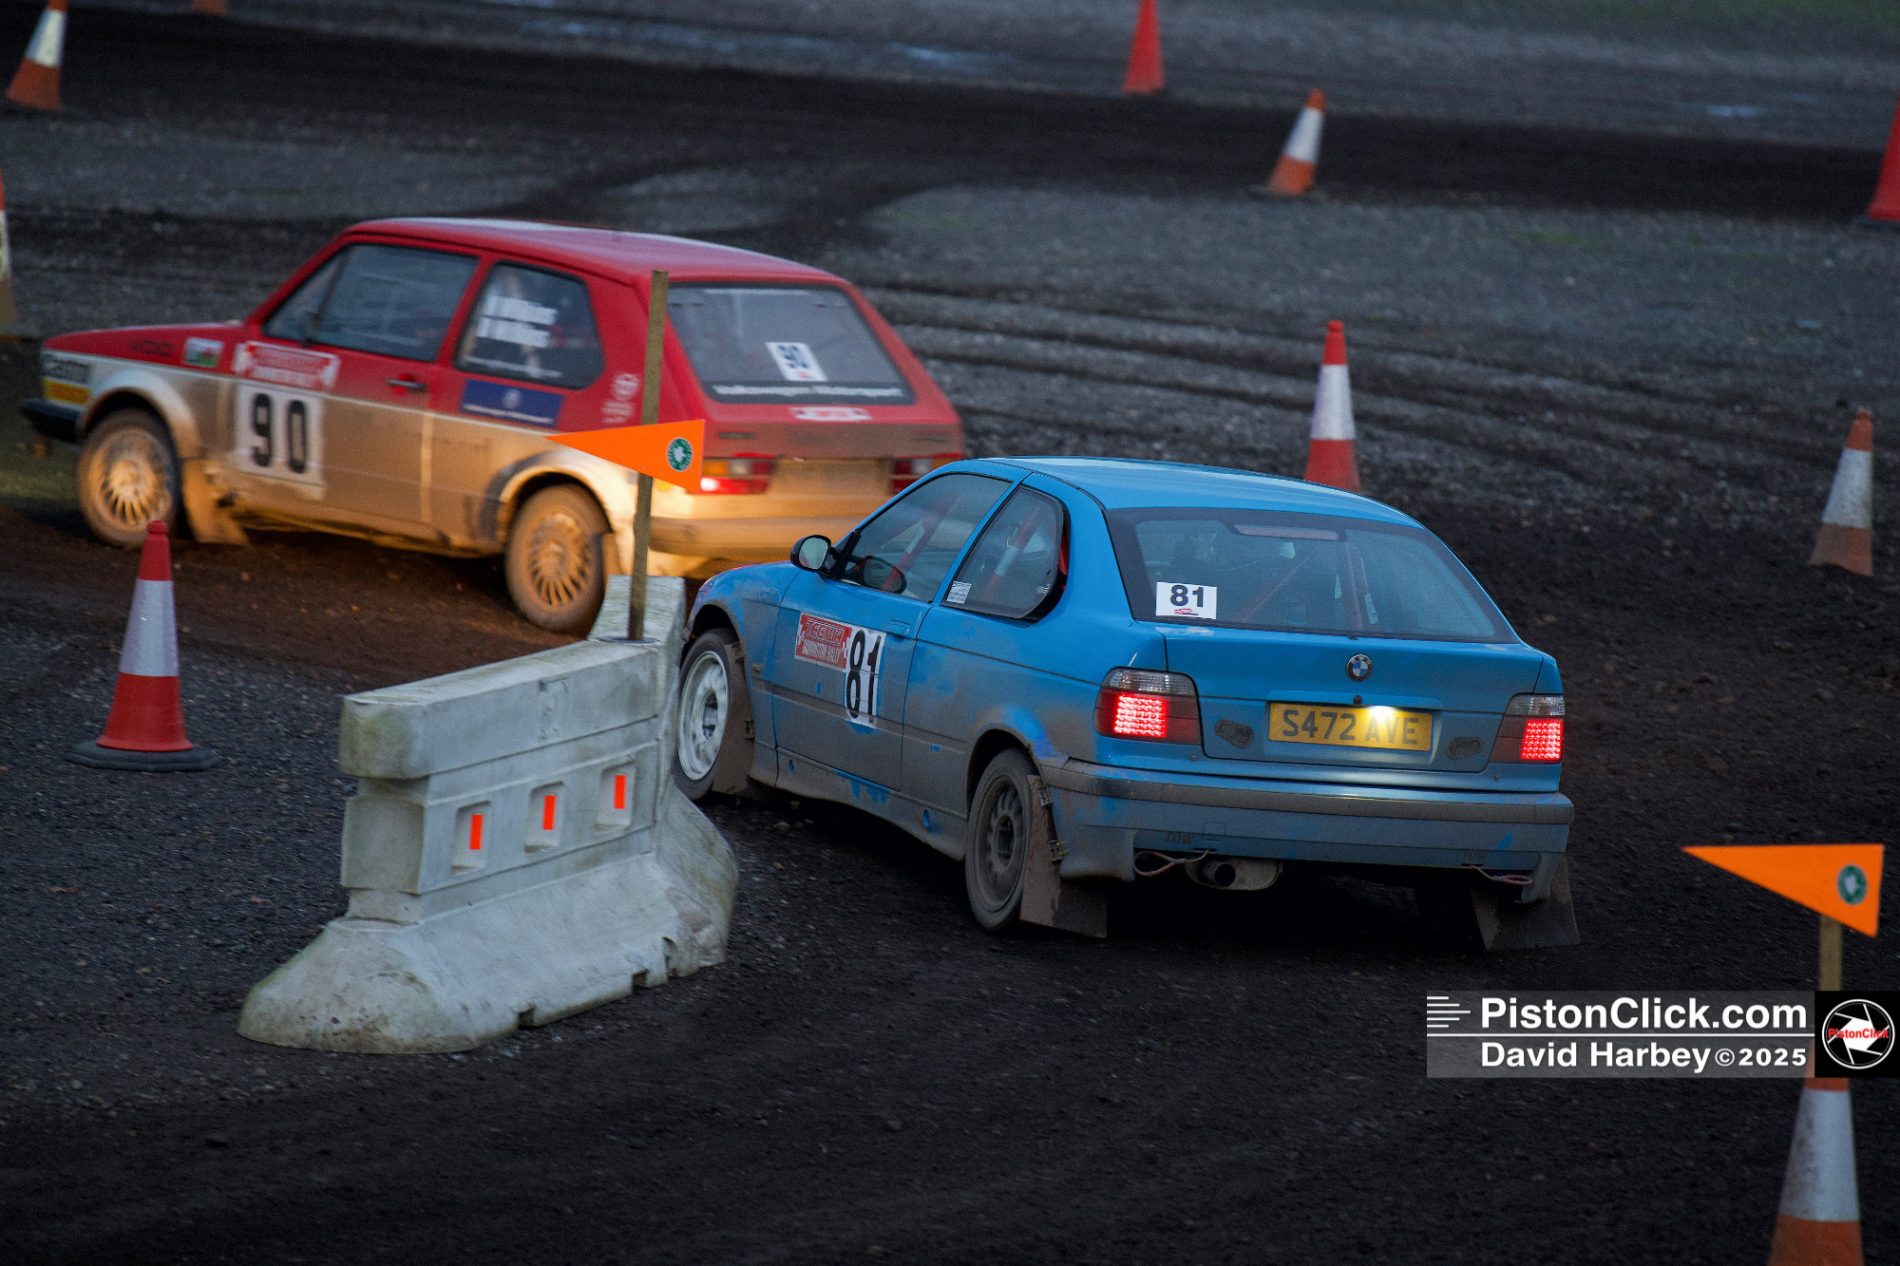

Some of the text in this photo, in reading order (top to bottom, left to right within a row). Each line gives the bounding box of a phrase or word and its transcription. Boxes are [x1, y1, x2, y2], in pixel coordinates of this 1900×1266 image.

[252, 393, 307, 474] 90
[1170, 584, 1204, 608] 81
[846, 629, 883, 723] 81
[1282, 709, 1419, 746] S472 AVE
